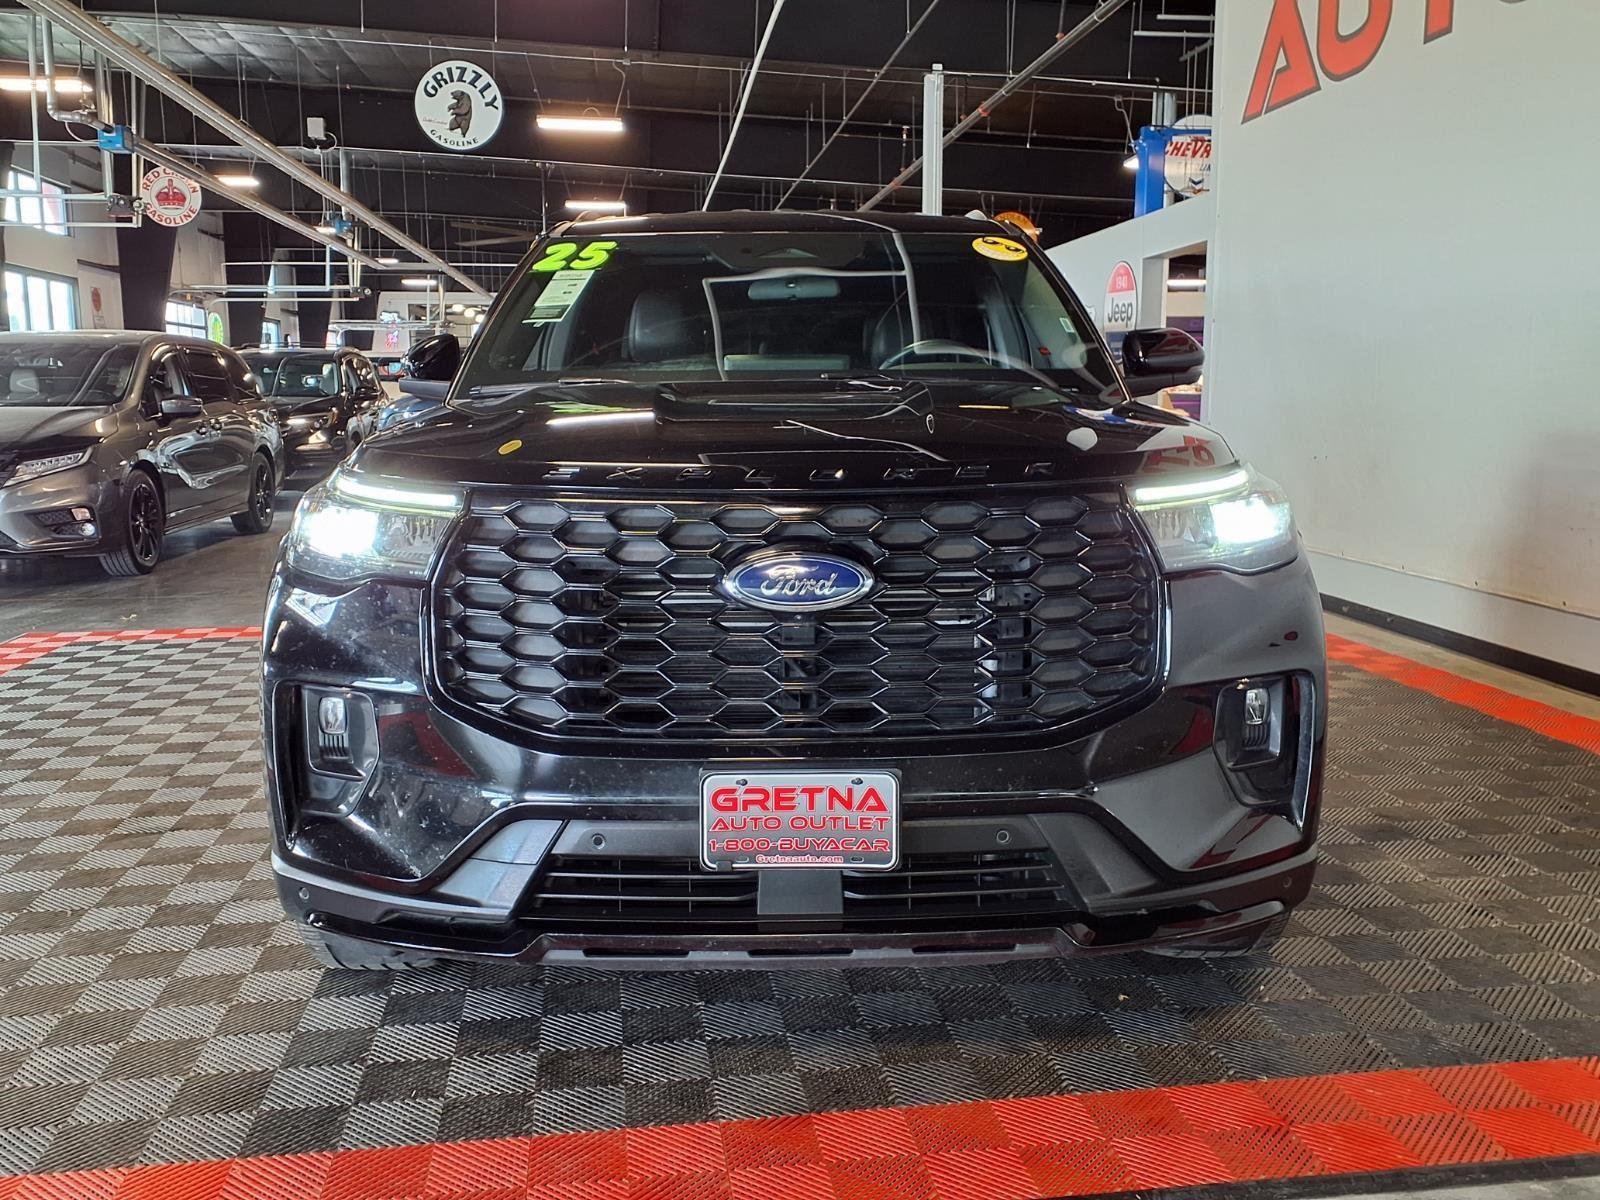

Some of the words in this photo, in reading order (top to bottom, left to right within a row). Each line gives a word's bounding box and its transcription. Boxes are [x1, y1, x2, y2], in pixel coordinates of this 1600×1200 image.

[423, 66, 499, 110] GRIZZLY
[430, 129, 479, 147] GASOLINE
[142, 170, 160, 191] RED
[145, 202, 197, 225] GASOLINE
[532, 241, 618, 272] 25
[1107, 297, 1133, 328] Jeep
[542, 462, 1053, 481] EXPLORER
[760, 565, 837, 597] Ford
[710, 785, 890, 813] GRETNA
[709, 816, 782, 832] AUTO
[788, 815, 891, 832] OUTLET
[708, 837, 890, 852] 1-800-BUYACAR
[756, 854, 844, 864] Gretnaauto.com
